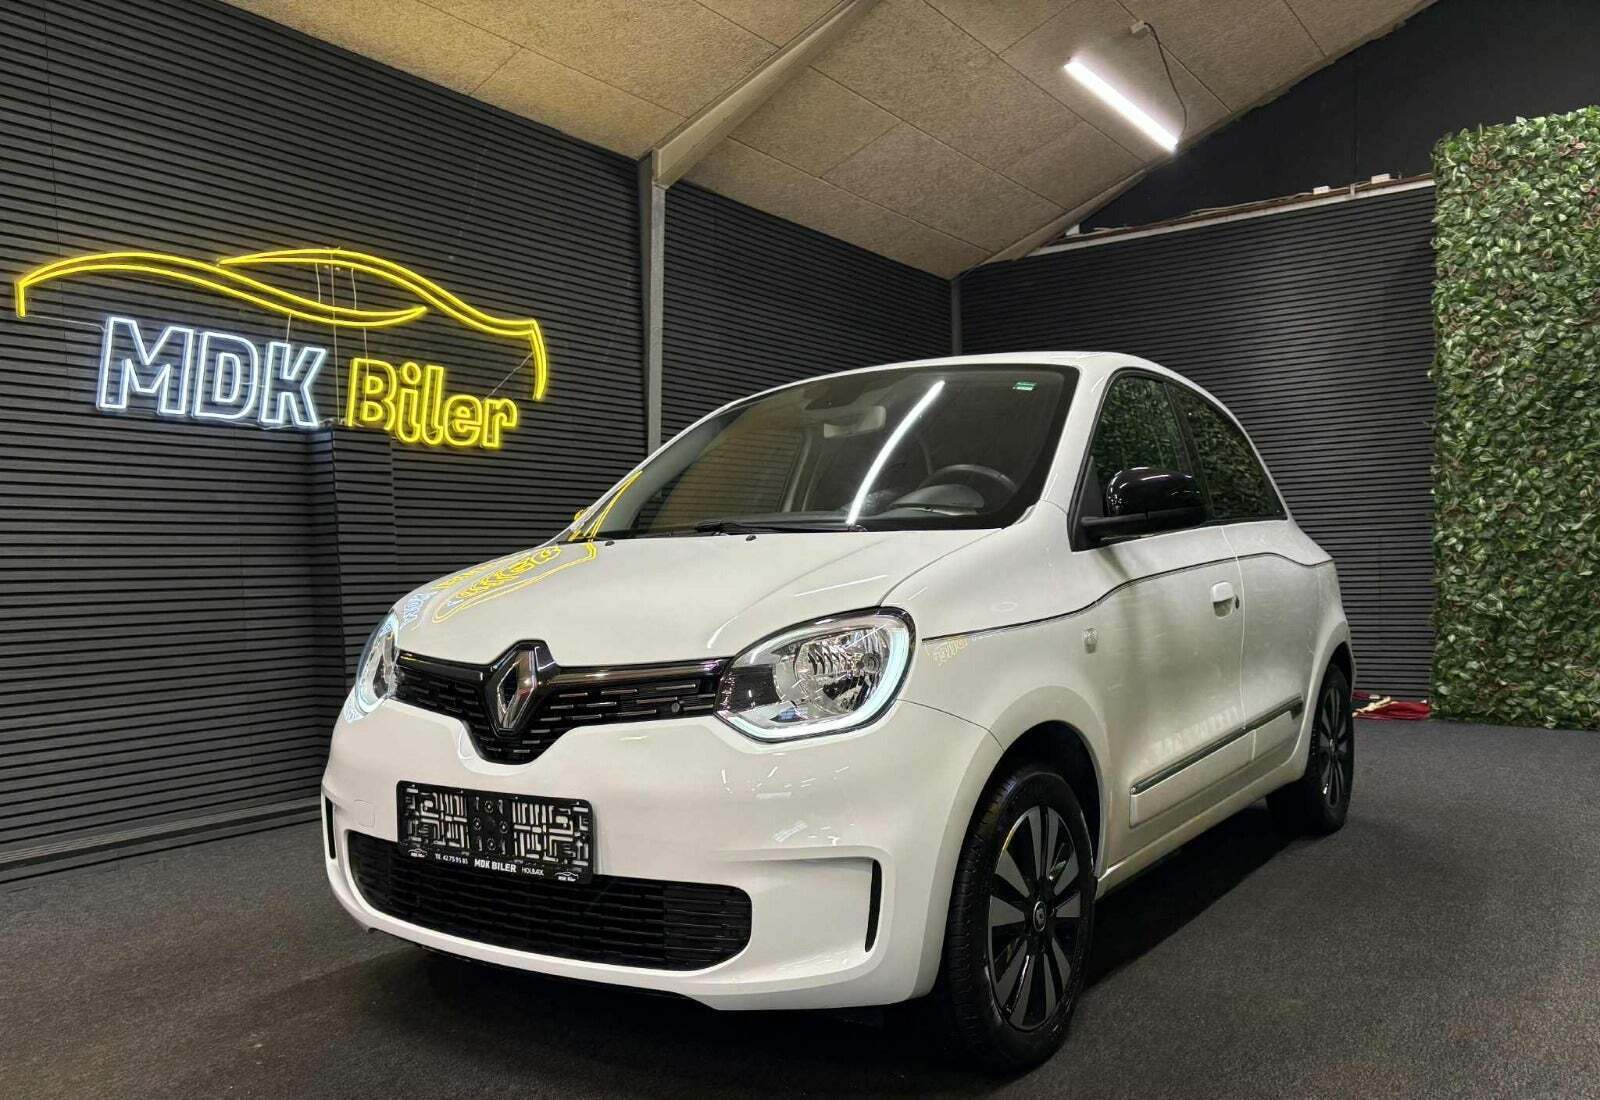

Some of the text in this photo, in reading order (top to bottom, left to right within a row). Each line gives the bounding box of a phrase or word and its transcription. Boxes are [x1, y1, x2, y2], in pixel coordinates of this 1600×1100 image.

[96, 315, 519, 448] MDK Biler
[474, 858, 490, 868] MDK
[491, 861, 517, 873] BILER
